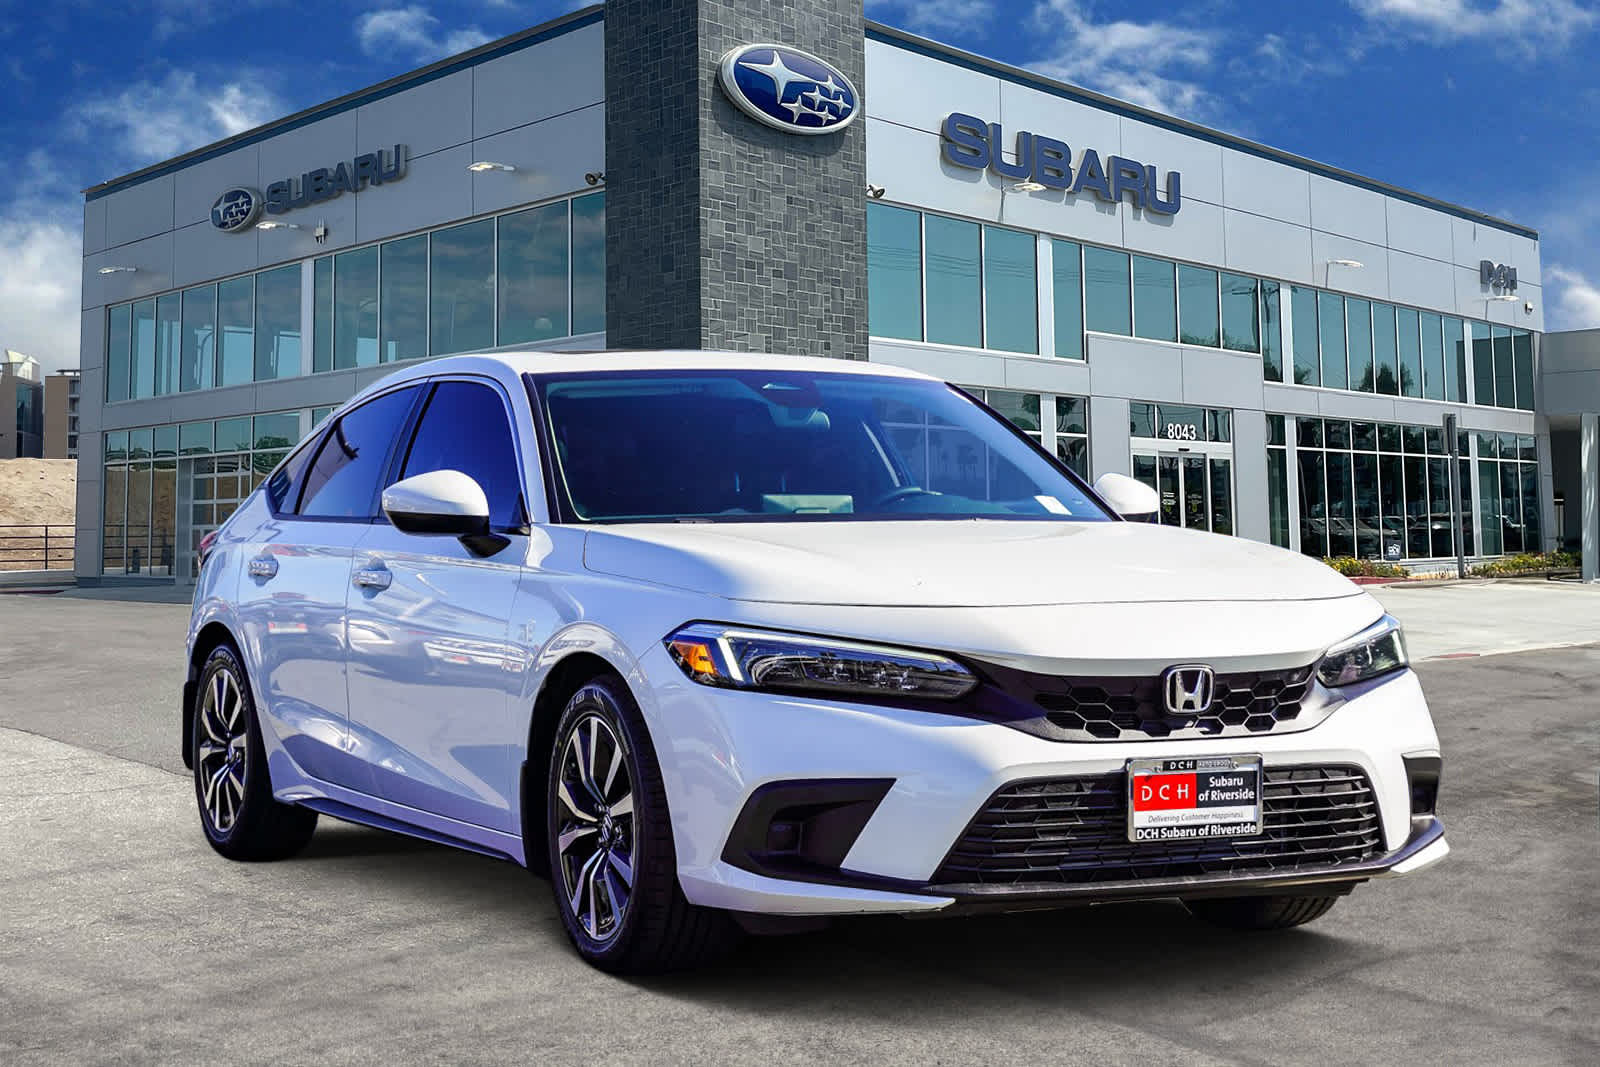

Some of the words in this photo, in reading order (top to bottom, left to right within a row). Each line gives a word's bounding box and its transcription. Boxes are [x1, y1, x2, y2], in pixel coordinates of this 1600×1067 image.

[940, 112, 1181, 215] SUBARU
[266, 144, 407, 215] SUBARU
[1167, 423, 1197, 440] 8043
[1209, 775, 1243, 787] Subaru
[1198, 790, 1210, 801] of
[1211, 788, 1255, 801] Riverside
[1148, 815, 1180, 823] Delivering
[1181, 813, 1210, 821] Customer
[1136, 829, 1159, 839] DCH
[1160, 827, 1197, 838] Subaru
[1198, 824, 1210, 836] of
[1210, 822, 1256, 835] Riverside
